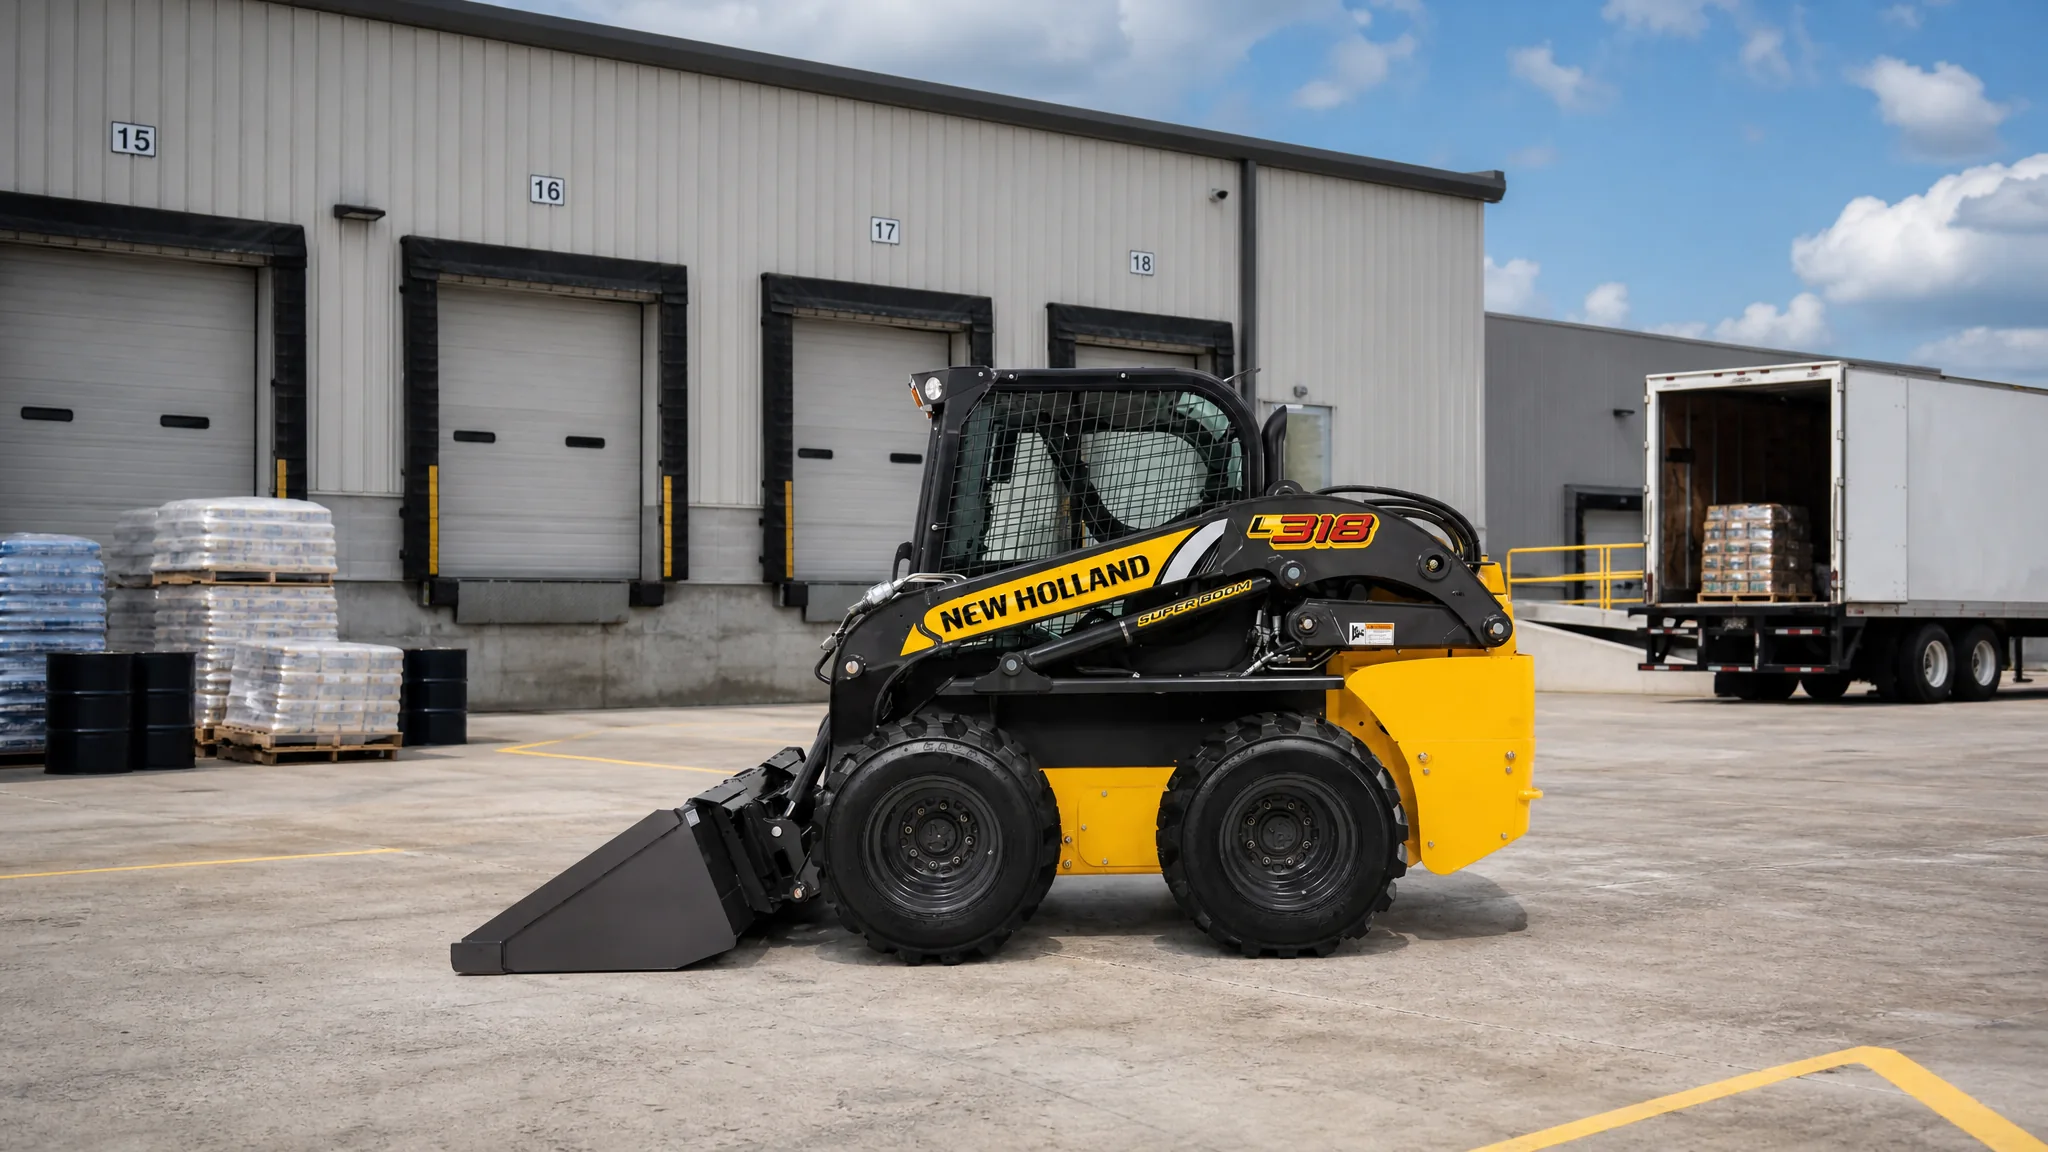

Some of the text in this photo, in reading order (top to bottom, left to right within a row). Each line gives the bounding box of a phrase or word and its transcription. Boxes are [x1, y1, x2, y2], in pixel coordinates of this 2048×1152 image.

[118, 127, 150, 151] 15
[535, 180, 560, 200] 16
[876, 221, 895, 240] 17
[1133, 255, 1151, 271] 18
[1248, 514, 1377, 546] L318
[940, 555, 1150, 632] NEW HOLLAND
[1139, 580, 1251, 625] SUPER BOOM
